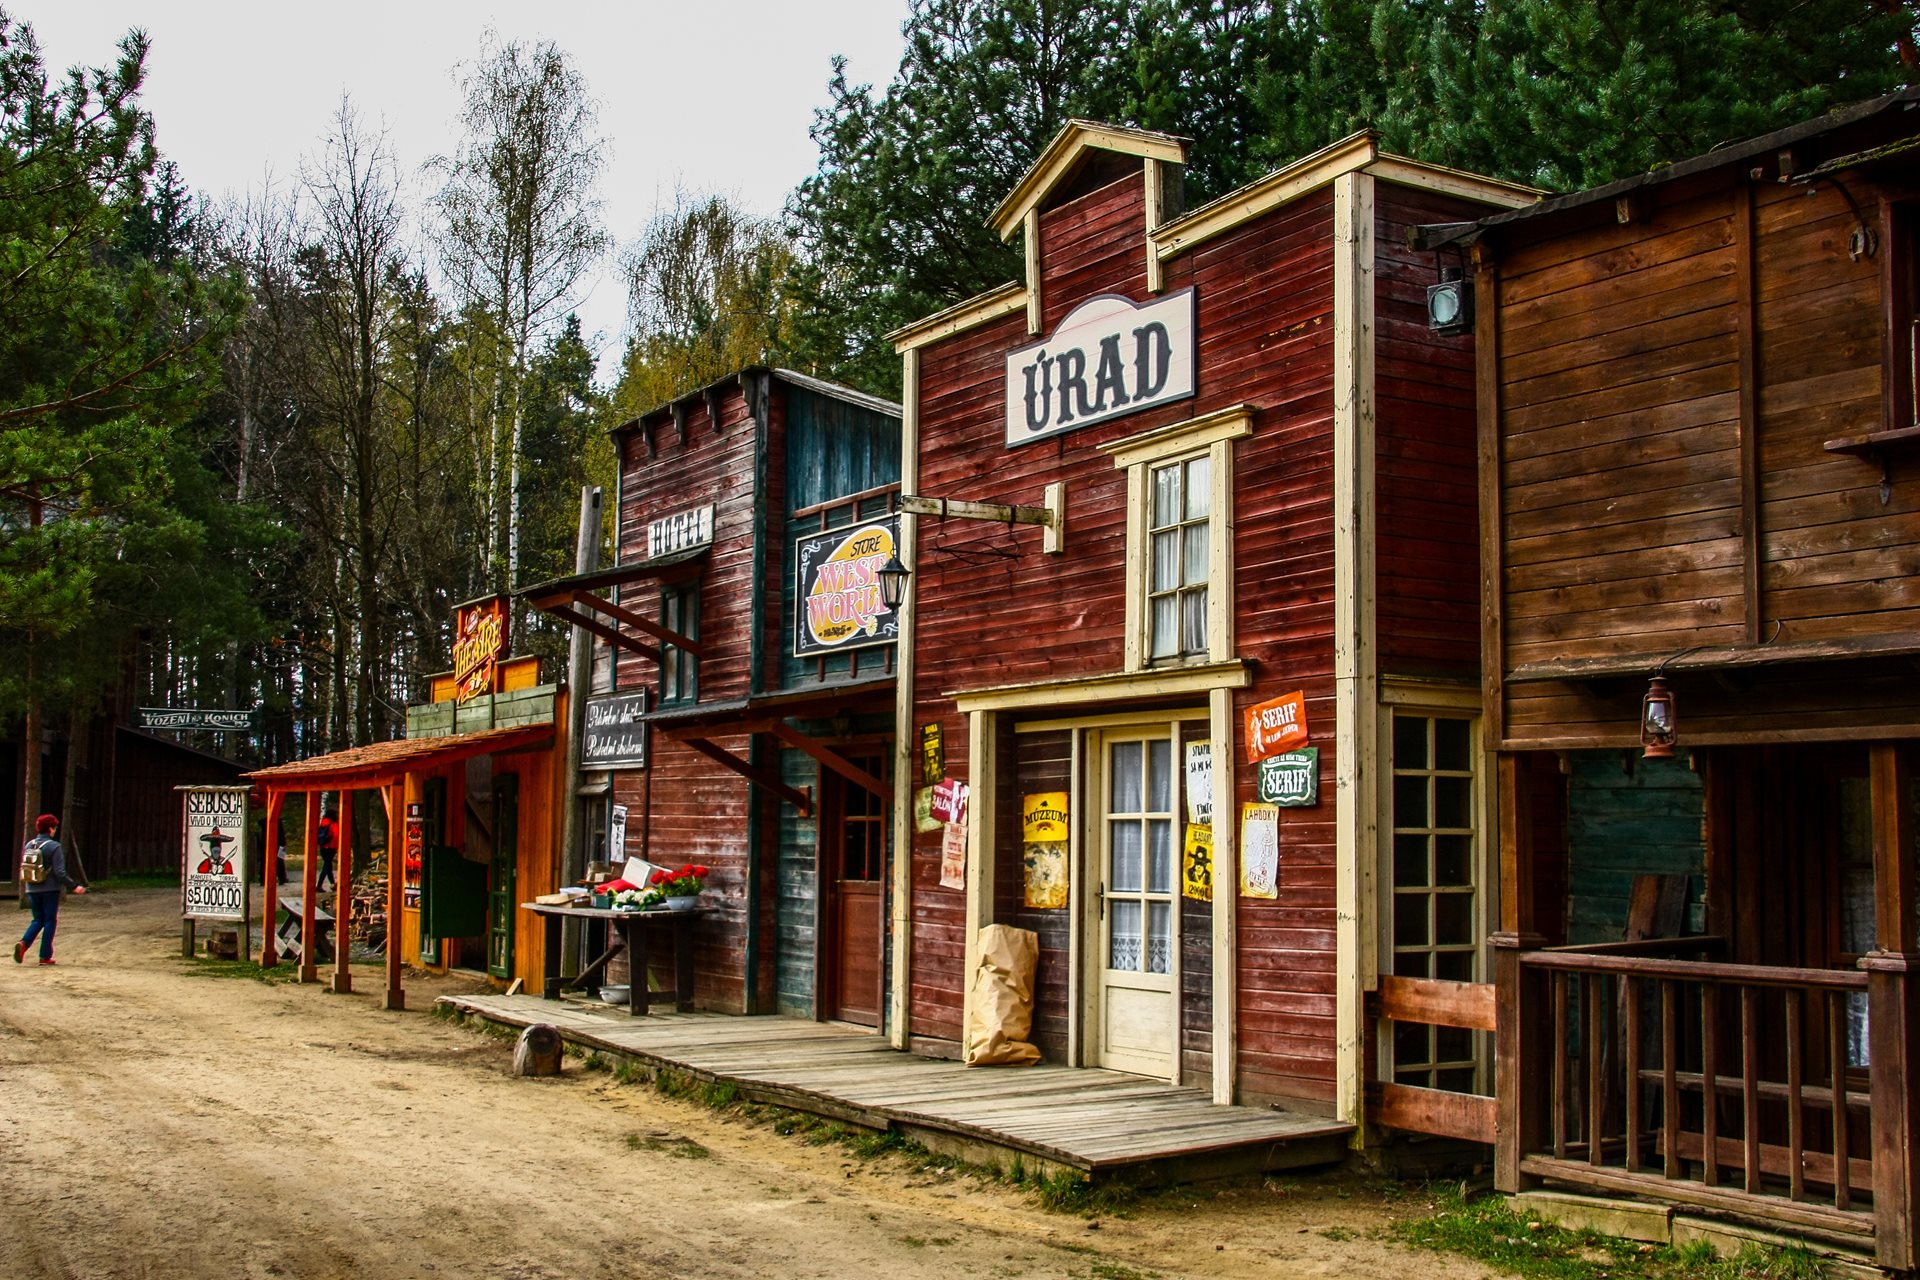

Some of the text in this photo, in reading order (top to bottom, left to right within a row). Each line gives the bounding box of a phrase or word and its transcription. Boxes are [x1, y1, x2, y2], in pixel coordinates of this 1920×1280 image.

[1022, 321, 1172, 431] ÚRAD
[654, 509, 703, 556] HOTEL
[850, 535, 882, 557] STORE
[817, 553, 887, 593] WEST
[453, 613, 502, 683] THEATRE
[1262, 702, 1297, 730] ŠERIF
[1267, 769, 1307, 794] ŠERIF
[190, 815, 242, 827] VIVO O MUERTO
[1025, 807, 1067, 826] MÚZEUM
